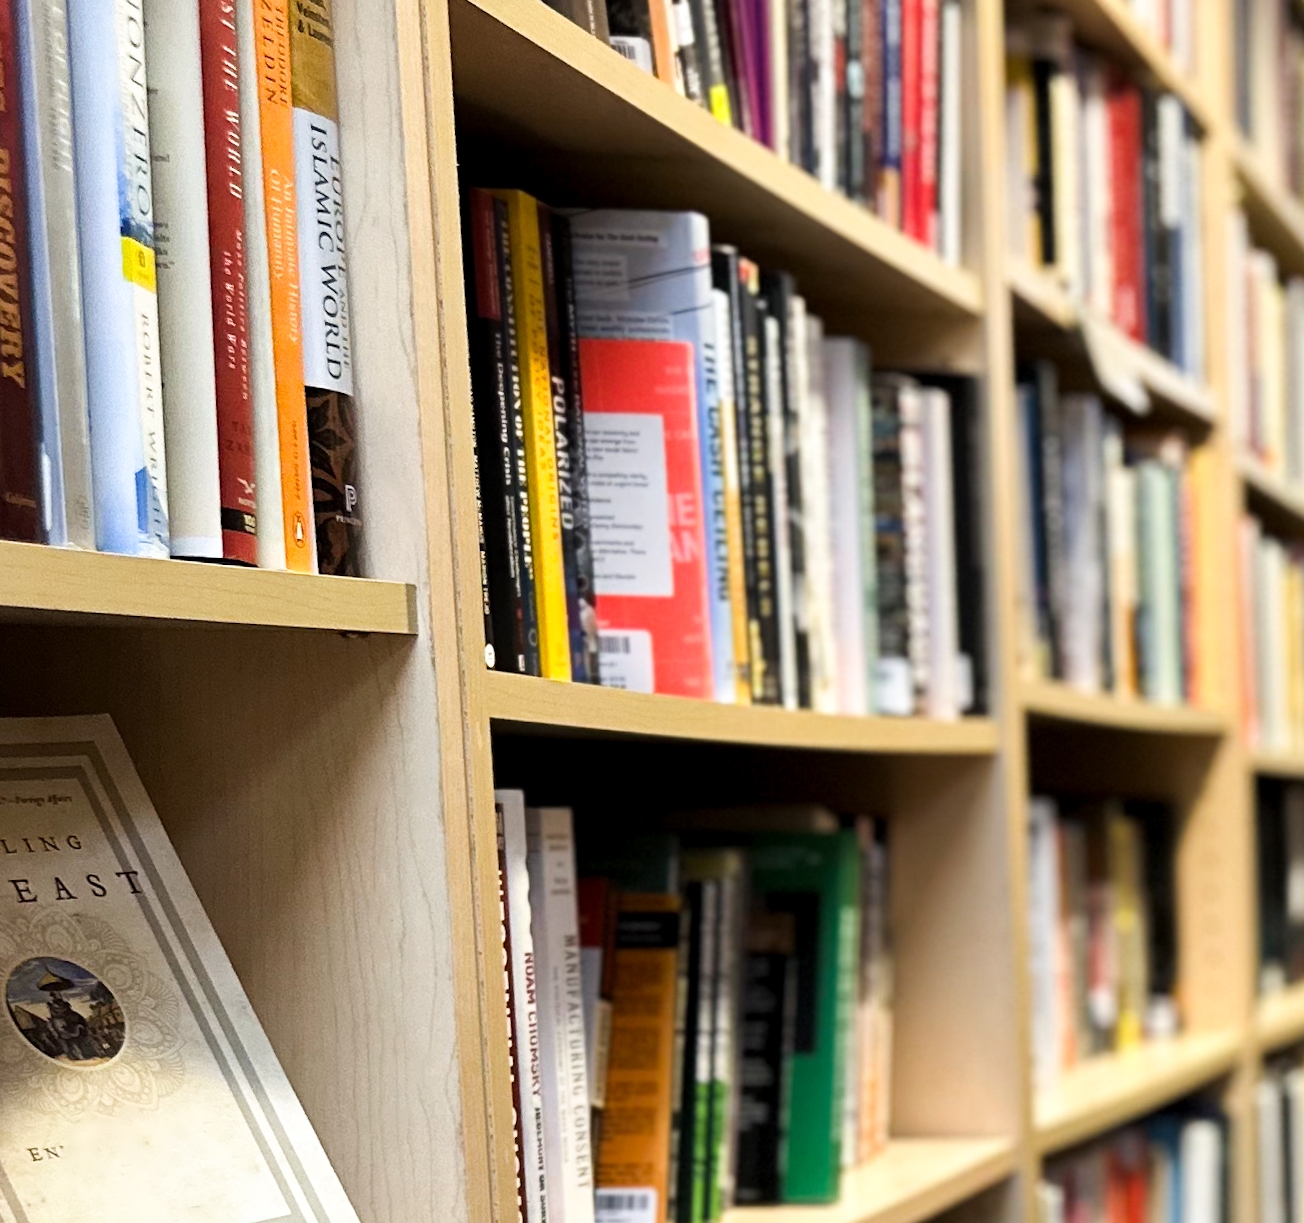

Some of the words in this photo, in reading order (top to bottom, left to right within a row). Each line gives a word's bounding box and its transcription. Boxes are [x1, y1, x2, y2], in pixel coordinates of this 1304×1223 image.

[221, 45, 239, 93] THE
[261, 0, 278, 105] ZELDIN
[275, 7, 288, 106] THEODORE
[223, 108, 243, 199] WORLD
[283, 175, 295, 202] An
[310, 124, 335, 253] ISLAMIC
[223, 251, 236, 276] the
[271, 197, 285, 281] Humanity
[284, 206, 298, 279] Intimate
[224, 282, 237, 327] World
[288, 282, 300, 343] History
[320, 265, 343, 381] WORLD
[140, 313, 156, 417] ROBERT
[226, 333, 238, 371] Wars
[497, 362, 510, 444] Deepening
[502, 446, 513, 486] Crisis
[550, 375, 575, 531] POLARIZED
[8, 870, 144, 904] EAST
[523, 951, 537, 1005] NOAM
[563, 934, 588, 1097] MANUFACTURING
[527, 1011, 542, 1098] CHOMSKY
[538, 1174, 547, 1192] OR
[572, 1104, 591, 1190] CONSENT
